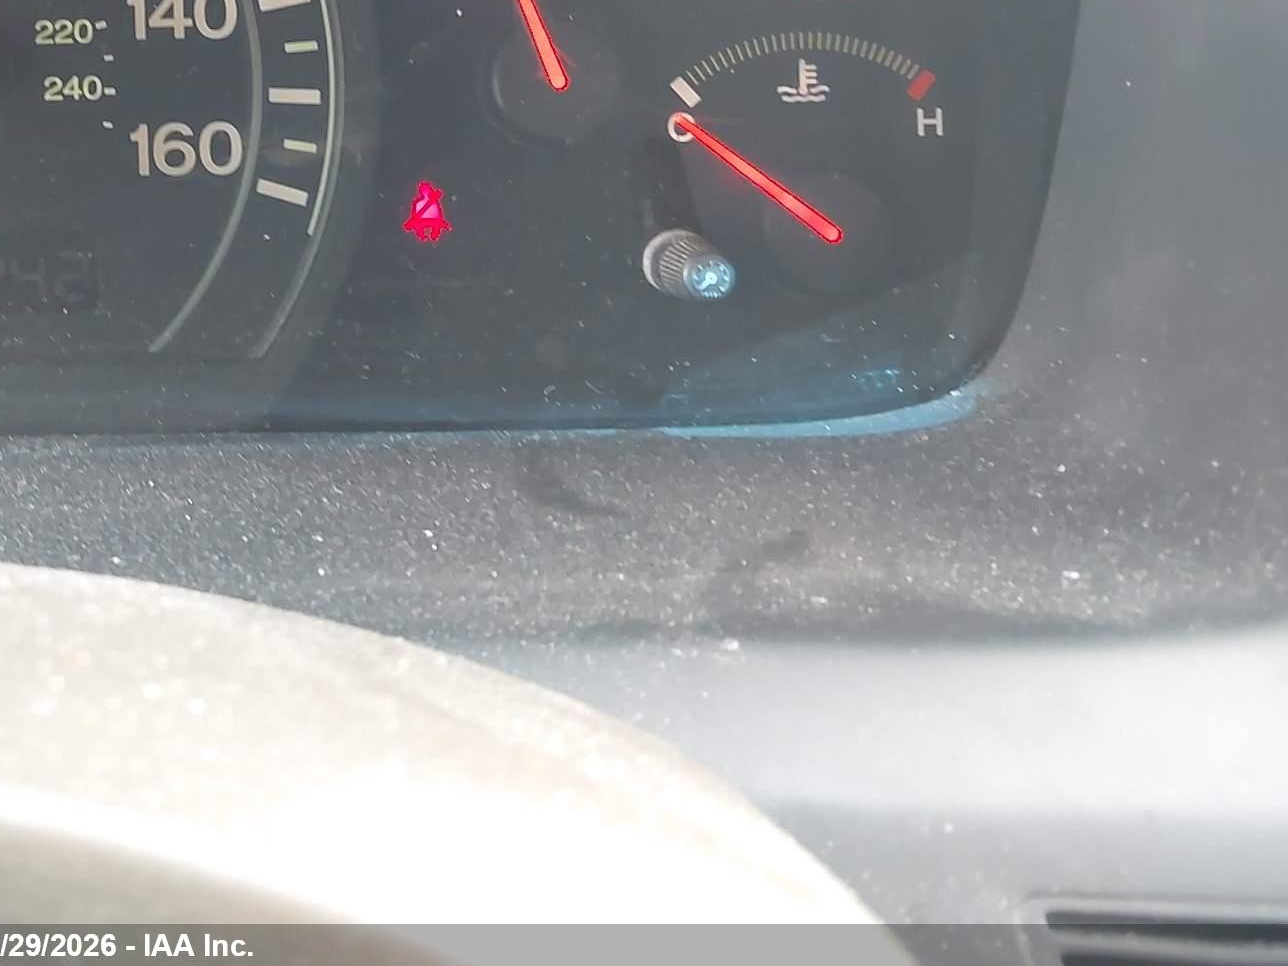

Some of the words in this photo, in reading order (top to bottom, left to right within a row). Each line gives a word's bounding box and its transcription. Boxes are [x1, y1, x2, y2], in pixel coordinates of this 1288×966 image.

[35, 18, 94, 44] 220
[43, 75, 103, 101] 240
[667, 111, 696, 143] C
[917, 107, 943, 135] H
[130, 121, 243, 177] 160
